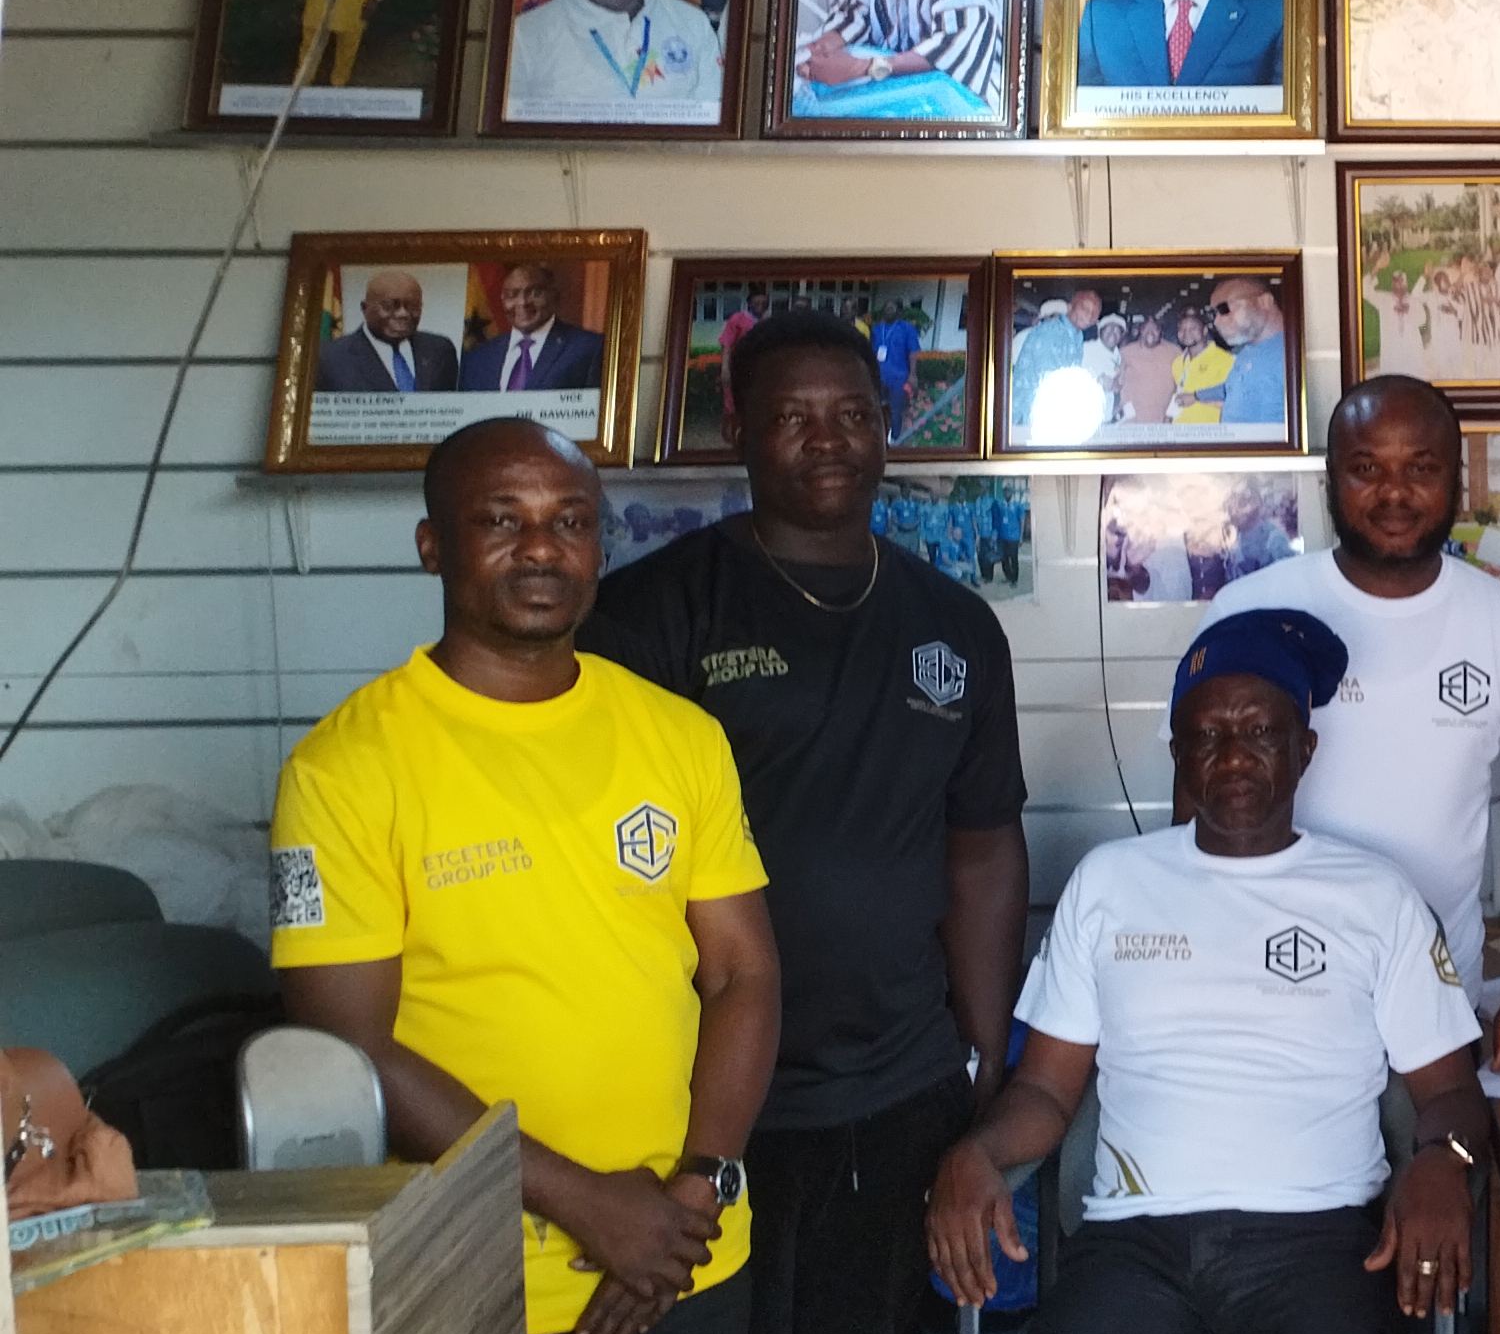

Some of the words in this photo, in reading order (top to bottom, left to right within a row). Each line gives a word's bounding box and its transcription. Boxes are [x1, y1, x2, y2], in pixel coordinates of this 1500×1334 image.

[1120, 89, 1142, 101] HIS
[1147, 89, 1229, 101] EXCELLENCY
[560, 392, 583, 404] VICE
[540, 408, 596, 420] BAWUMIA
[422, 836, 526, 873] ETCETERA
[426, 860, 497, 891] GROUP
[501, 853, 533, 875] LTD
[1114, 933, 1189, 947] ETCETERA
[1114, 948, 1162, 962] GROUP
[1165, 948, 1192, 961] LTD
